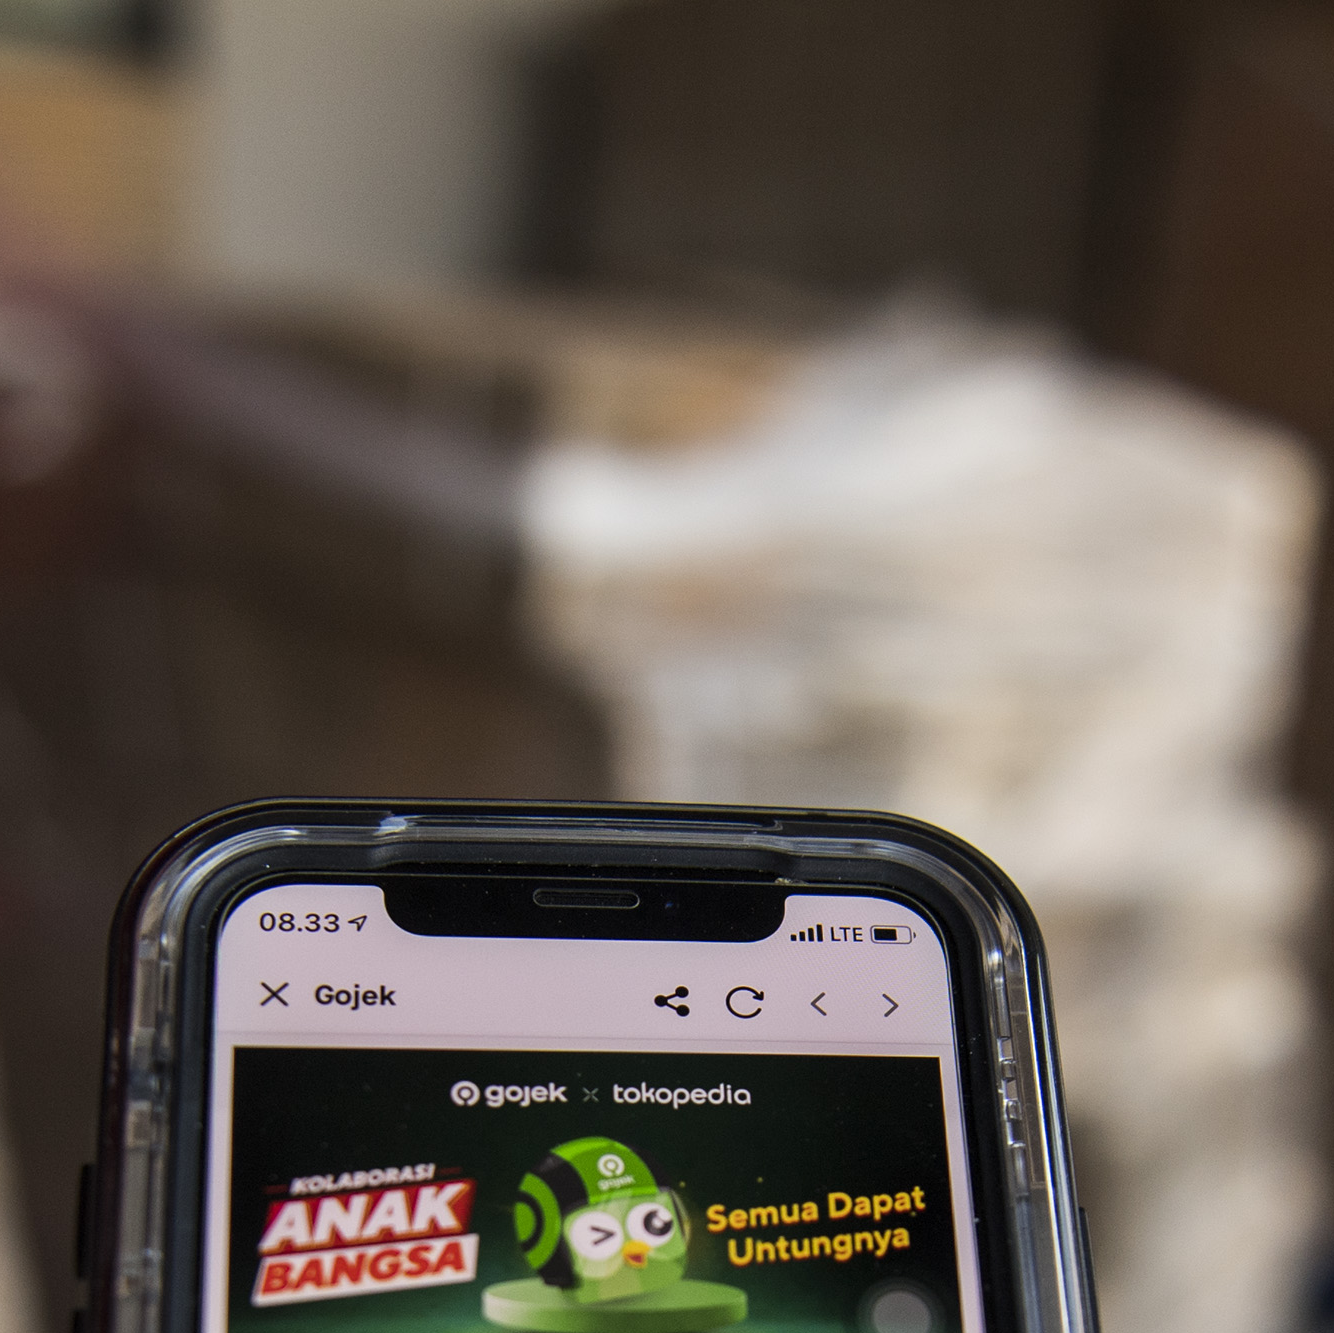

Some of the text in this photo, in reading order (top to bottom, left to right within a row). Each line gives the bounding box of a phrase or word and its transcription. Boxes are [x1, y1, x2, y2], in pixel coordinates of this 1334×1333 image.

[259, 912, 341, 934] 08.33
[830, 926, 864, 943] LTE
[314, 983, 396, 1011] Gojek
[485, 1080, 568, 1108] gojek
[612, 1081, 752, 1109] tokopedia
[290, 1163, 436, 1195] KOLABORASI
[259, 1181, 472, 1253] ANAK
[707, 1184, 926, 1234] Semua Dapat
[727, 1224, 911, 1267] Untungnya
[260, 1240, 466, 1299] BANGSA
